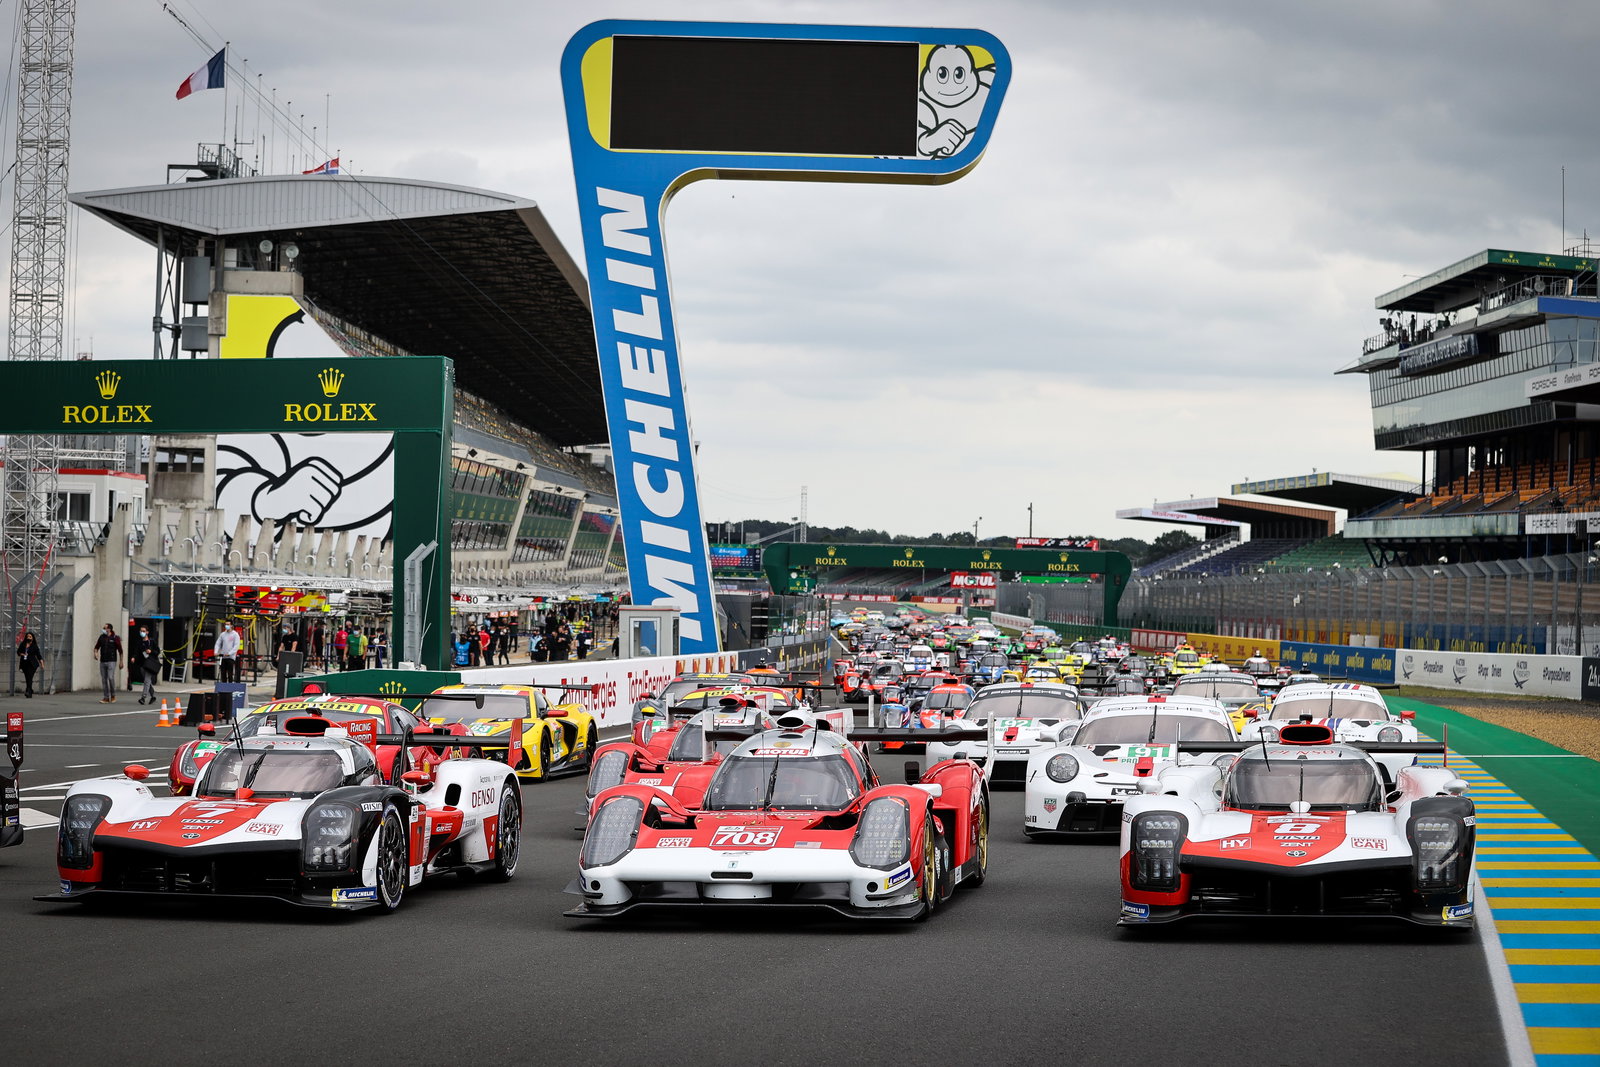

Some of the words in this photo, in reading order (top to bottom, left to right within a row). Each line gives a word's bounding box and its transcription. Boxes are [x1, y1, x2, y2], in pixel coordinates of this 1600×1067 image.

[1532, 377, 1557, 391] PORSCHE
[62, 405, 152, 424] ROLEX
[284, 402, 377, 422] ROLEX
[596, 186, 703, 642] MICHELIN
[815, 557, 847, 566] ROLEX
[893, 559, 925, 568] ROLEX
[970, 561, 1003, 570] ROLEX
[1048, 563, 1080, 572] ROLEX
[953, 575, 996, 587] MOTUL
[1543, 667, 1571, 684] #PurposeDriven
[1284, 691, 1375, 699] PORSCHE
[350, 722, 371, 732] RACING
[1005, 719, 1028, 727] 92
[1135, 747, 1164, 758] 91
[471, 787, 495, 809] DENSO
[196, 807, 236, 818] 7
[132, 821, 155, 830] HY
[249, 826, 278, 835] CAR
[1274, 823, 1321, 834] 8
[712, 831, 775, 846] 708
[1222, 839, 1249, 849] HY
[1354, 841, 1385, 849] CAR
